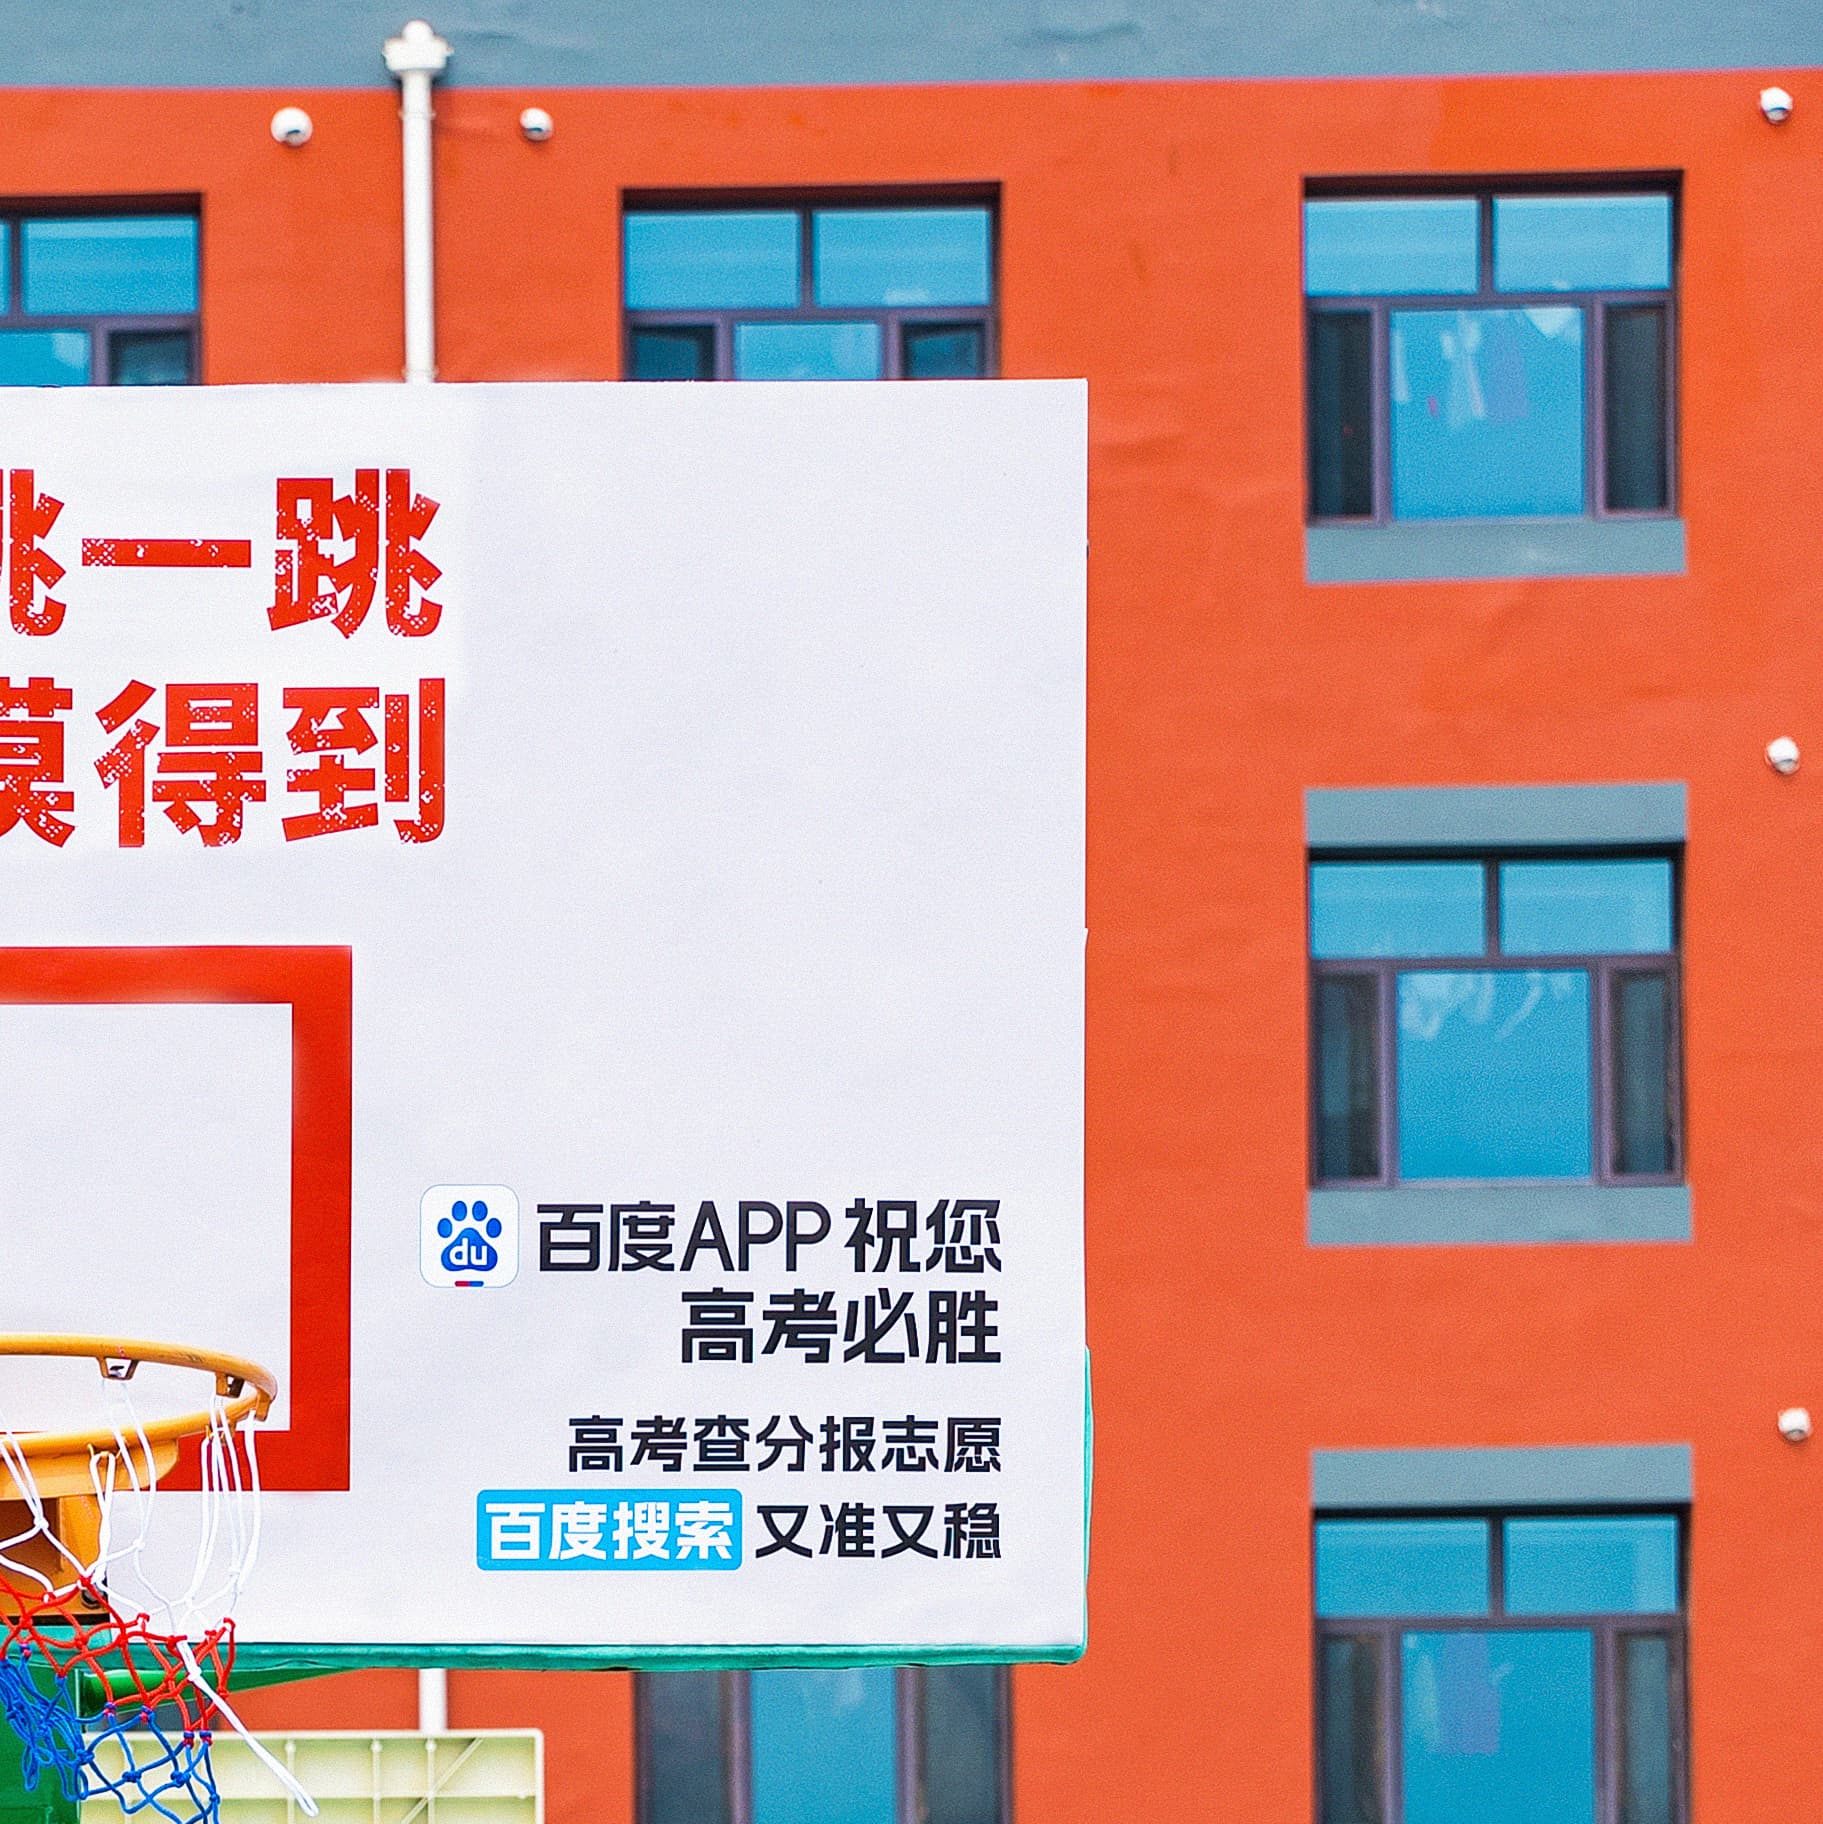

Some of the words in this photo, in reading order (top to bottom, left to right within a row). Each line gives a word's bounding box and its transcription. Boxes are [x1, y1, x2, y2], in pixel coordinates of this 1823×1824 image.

[449, 1237, 487, 1266] du
[681, 1286, 1002, 1364] 高考必胜
[568, 1414, 1002, 1473] 高考查分报志愿
[486, 1501, 734, 1560] 百度搜索
[755, 1502, 1002, 1559] 又准又稳
